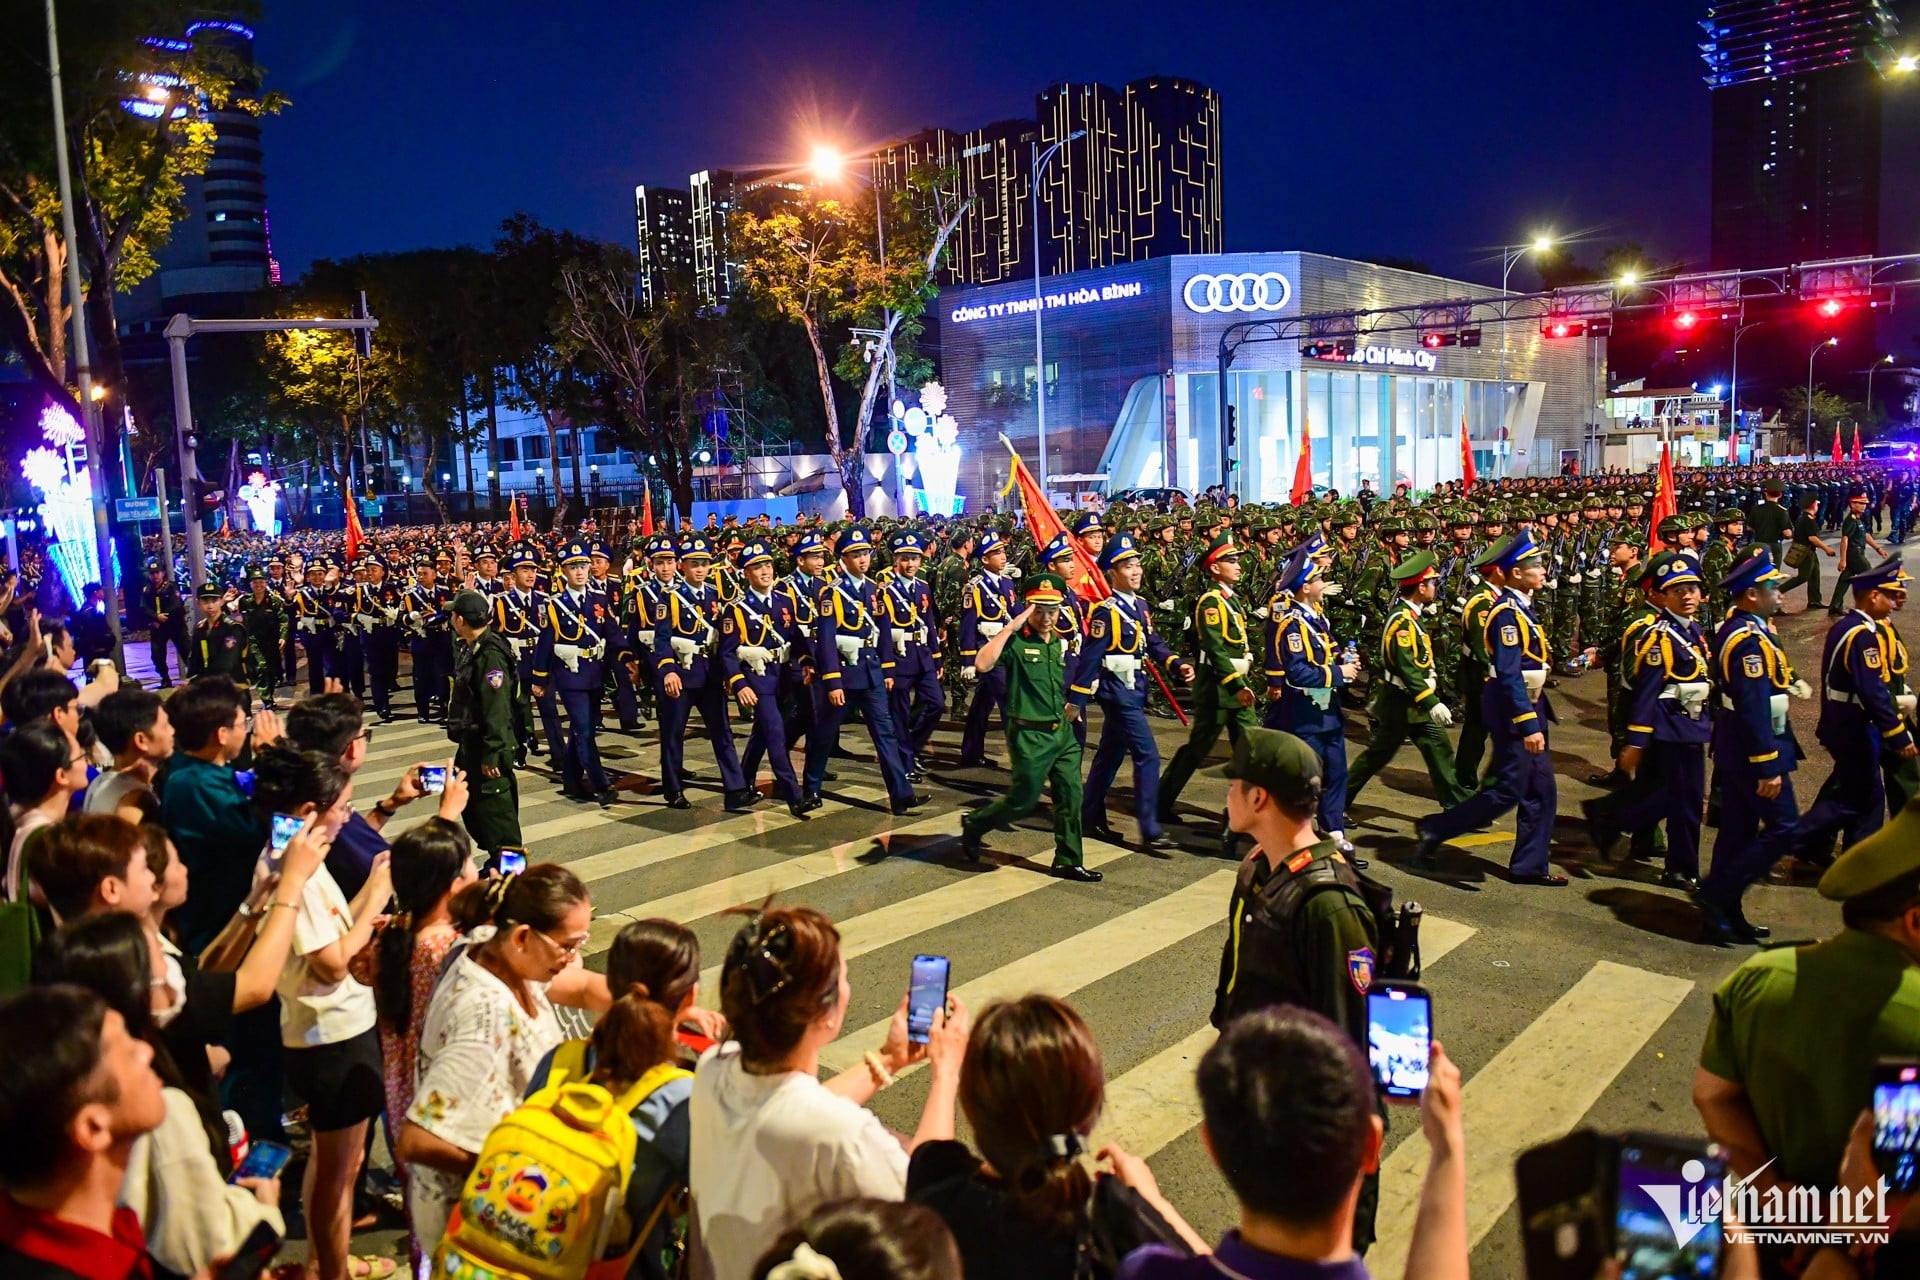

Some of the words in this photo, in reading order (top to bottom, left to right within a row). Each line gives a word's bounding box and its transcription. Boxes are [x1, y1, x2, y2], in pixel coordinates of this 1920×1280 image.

[952, 306, 987, 322] CÔNG
[988, 303, 1005, 317] TY
[1006, 298, 1043, 314] TNHH
[1044, 294, 1066, 308] TM
[1068, 288, 1100, 305] HÒA
[1102, 282, 1141, 300] BÌNH
[1366, 346, 1386, 364] Chi
[1387, 347, 1415, 367] Minh
[1415, 350, 1437, 372] City
